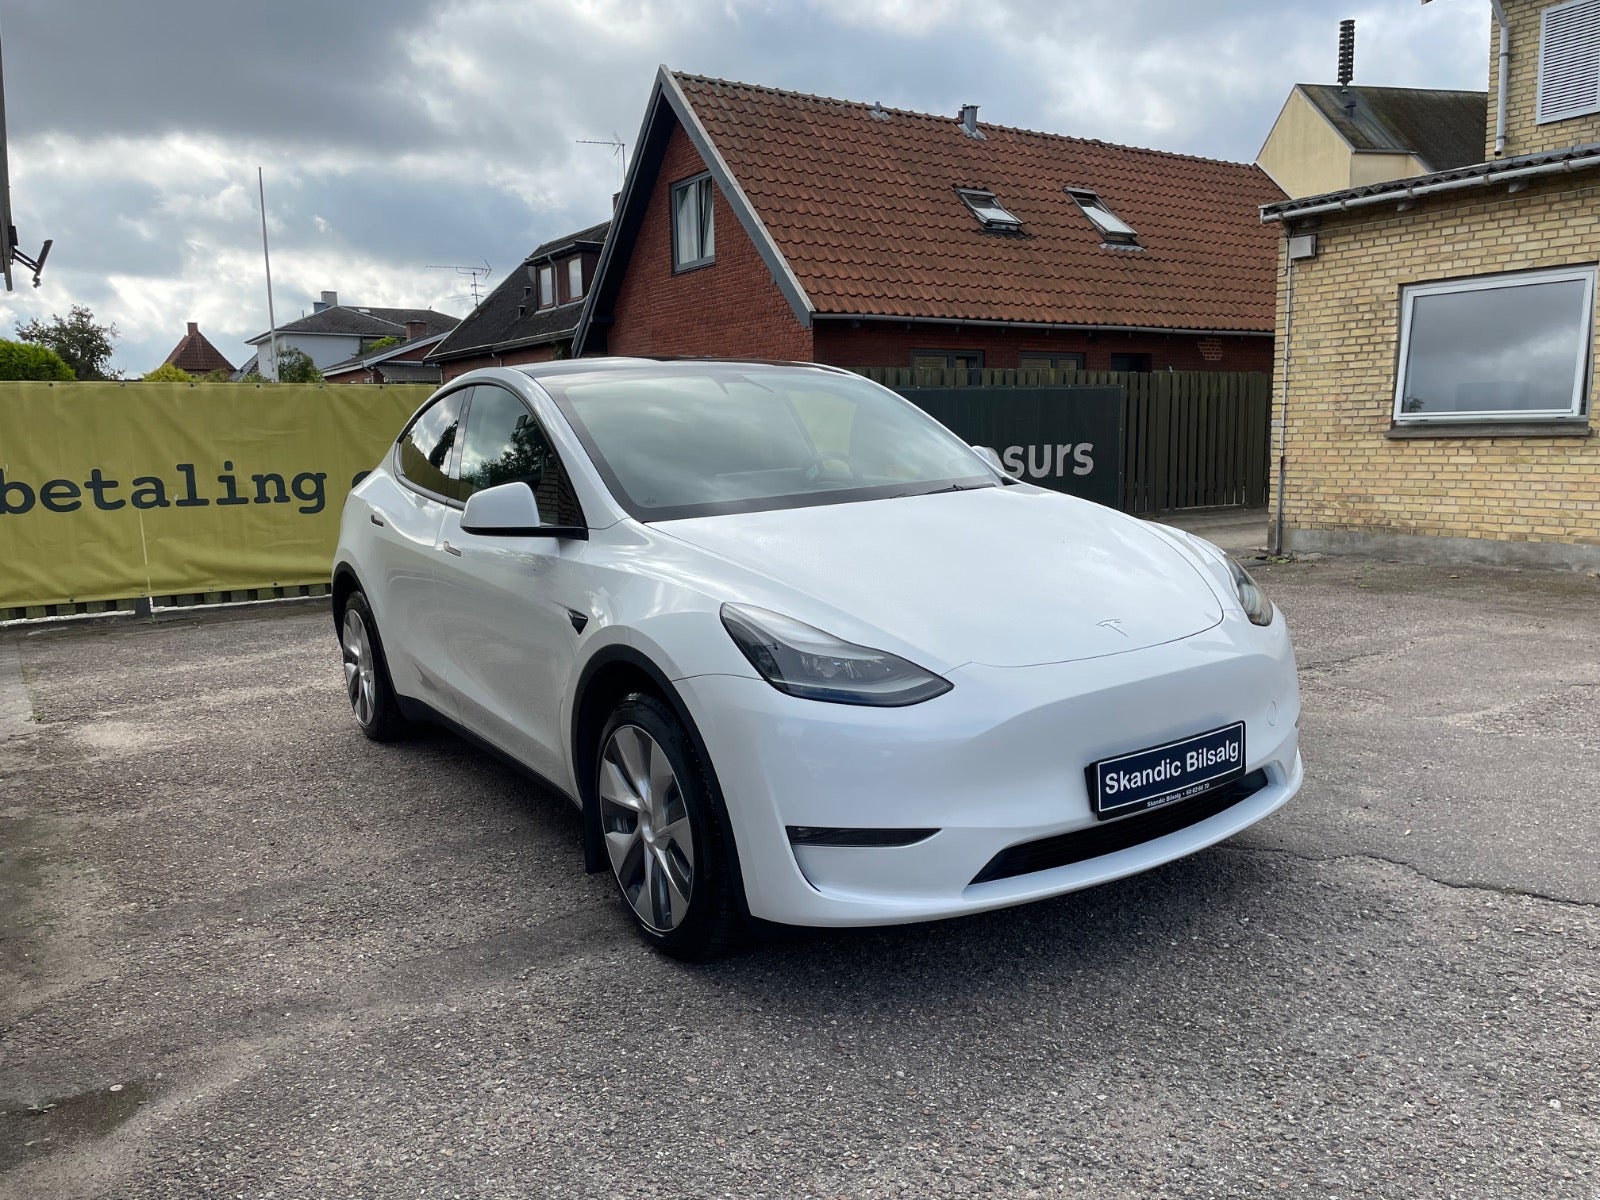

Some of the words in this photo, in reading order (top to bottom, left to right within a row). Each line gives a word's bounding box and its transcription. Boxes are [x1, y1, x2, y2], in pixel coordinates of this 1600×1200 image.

[0, 460, 327, 514] betaling
[1105, 758, 1182, 794] Skandic
[1186, 740, 1239, 772] Bilsalg
